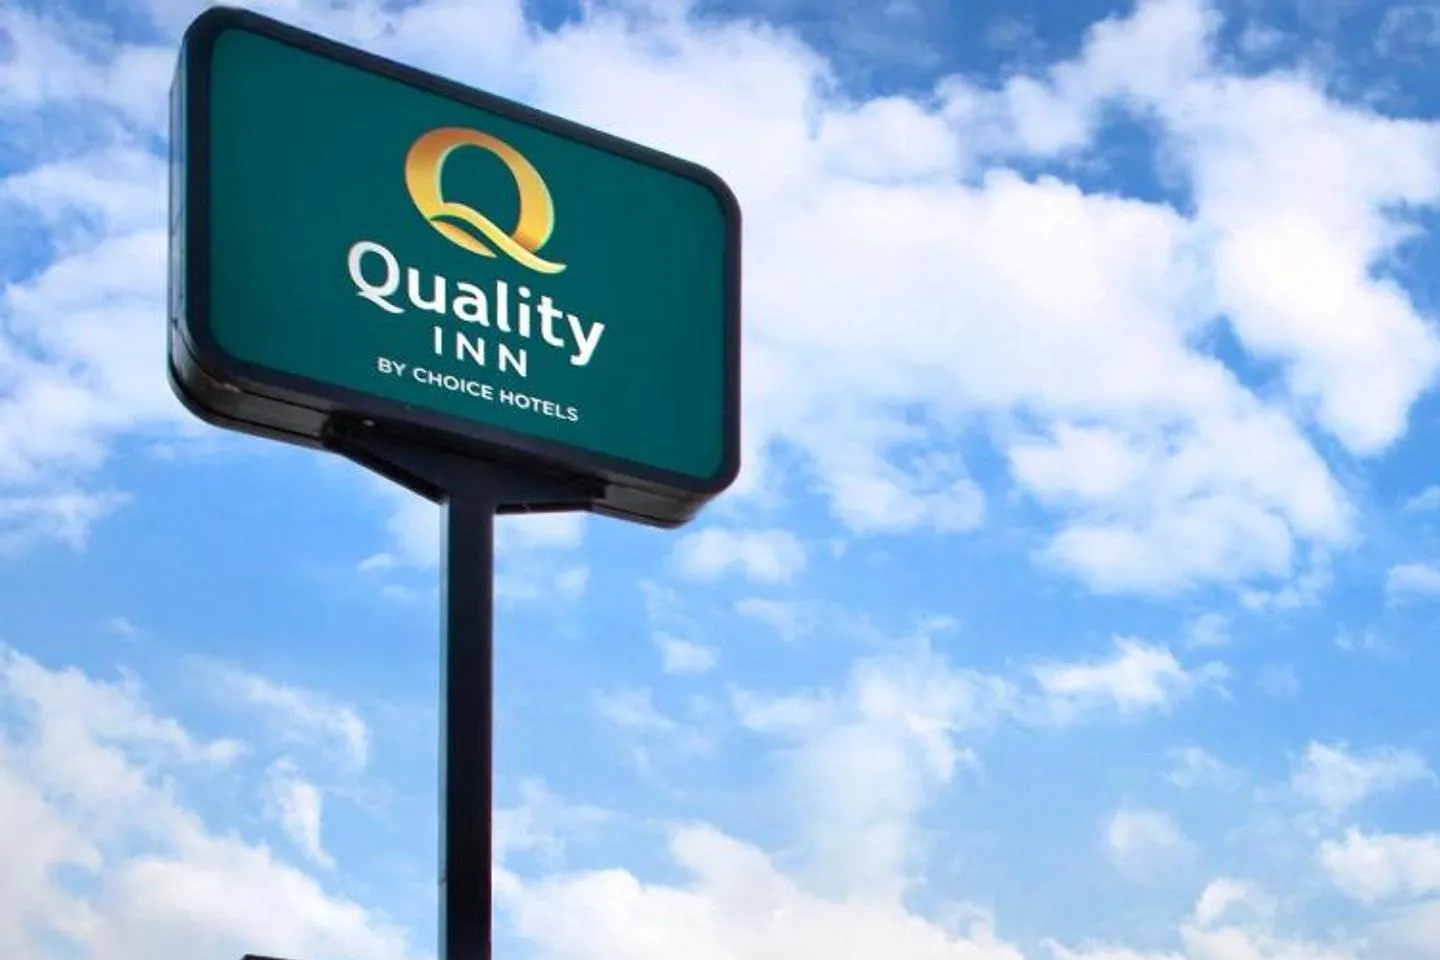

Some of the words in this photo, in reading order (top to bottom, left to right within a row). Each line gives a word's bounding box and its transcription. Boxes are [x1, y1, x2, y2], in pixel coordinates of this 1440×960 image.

[404, 126, 567, 274] Q
[347, 240, 605, 366] Quality
[377, 356, 406, 377] BY
[413, 367, 494, 400] CHOICE
[499, 389, 579, 421] HOTELS
[433, 326, 527, 377] INN
